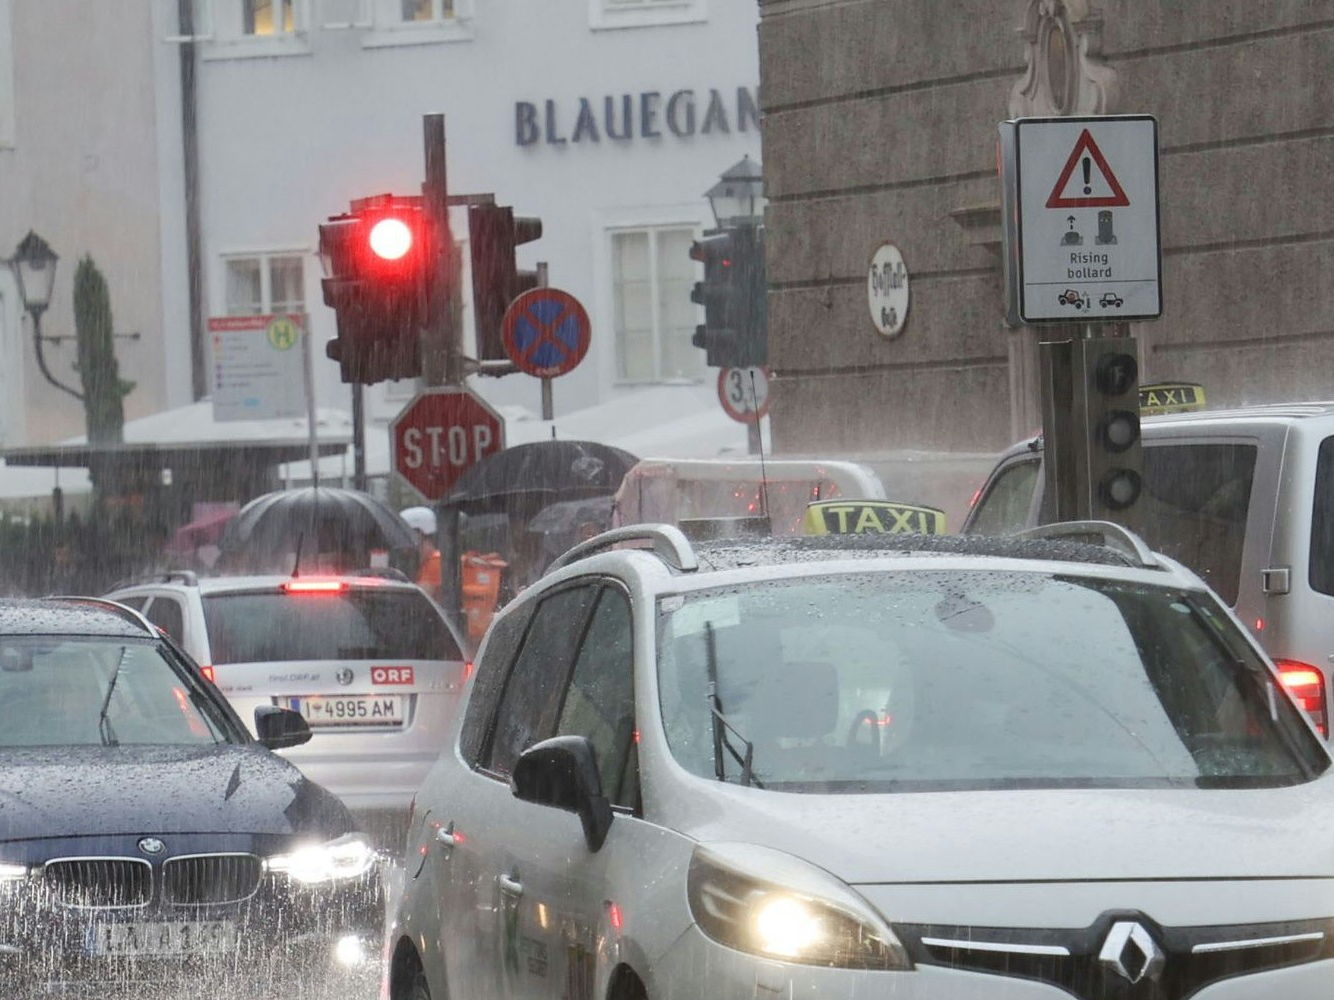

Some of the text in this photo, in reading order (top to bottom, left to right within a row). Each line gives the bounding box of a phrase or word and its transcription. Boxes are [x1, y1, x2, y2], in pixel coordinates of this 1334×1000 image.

[1070, 252, 1108, 265] Rising
[1068, 267, 1112, 279] bollard
[1140, 389, 1187, 406] AXI
[404, 425, 491, 468] STOP
[827, 507, 928, 535] TAXI
[373, 668, 412, 683] ORF
[325, 701, 367, 718] 4995
[372, 702, 394, 718] AM
